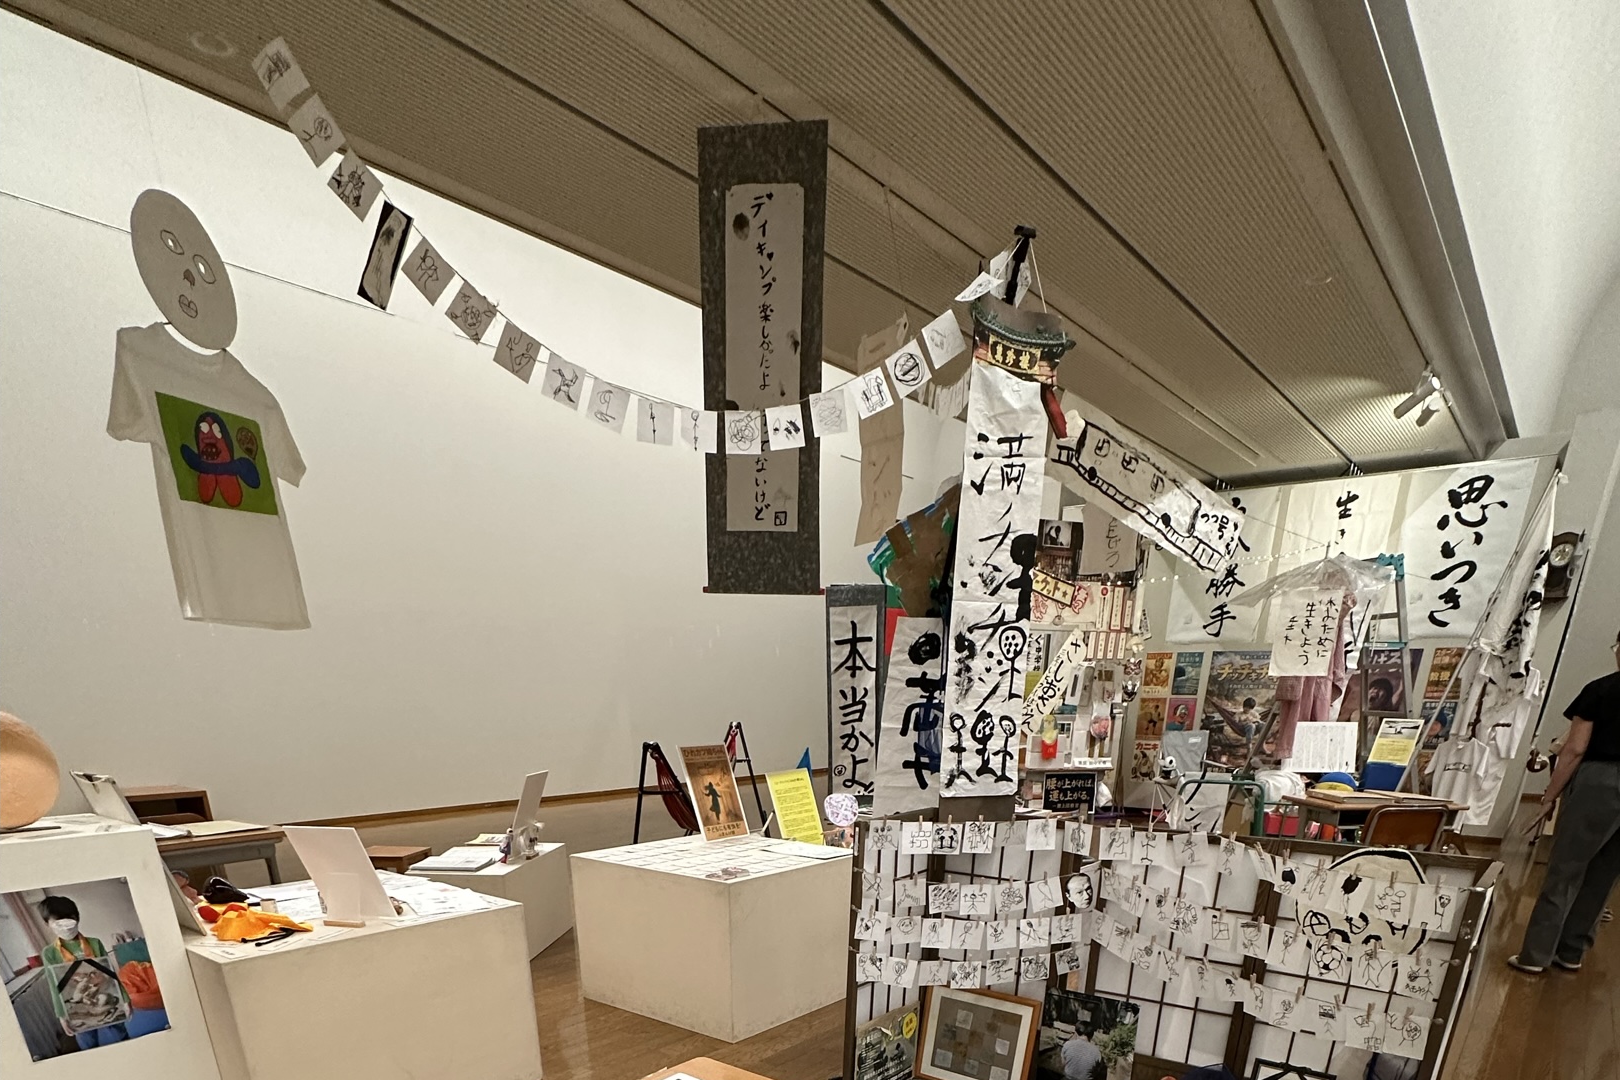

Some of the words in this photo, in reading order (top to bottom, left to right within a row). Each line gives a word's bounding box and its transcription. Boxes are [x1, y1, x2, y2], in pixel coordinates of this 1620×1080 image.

[1427, 474, 1509, 628] 思いつき
[831, 620, 876, 794] 本当かよ
[1135, 742, 1159, 751] カニキ
[1045, 778, 1094, 790] 腰が上がれば、
[1048, 790, 1091, 801] 運も上がる。
